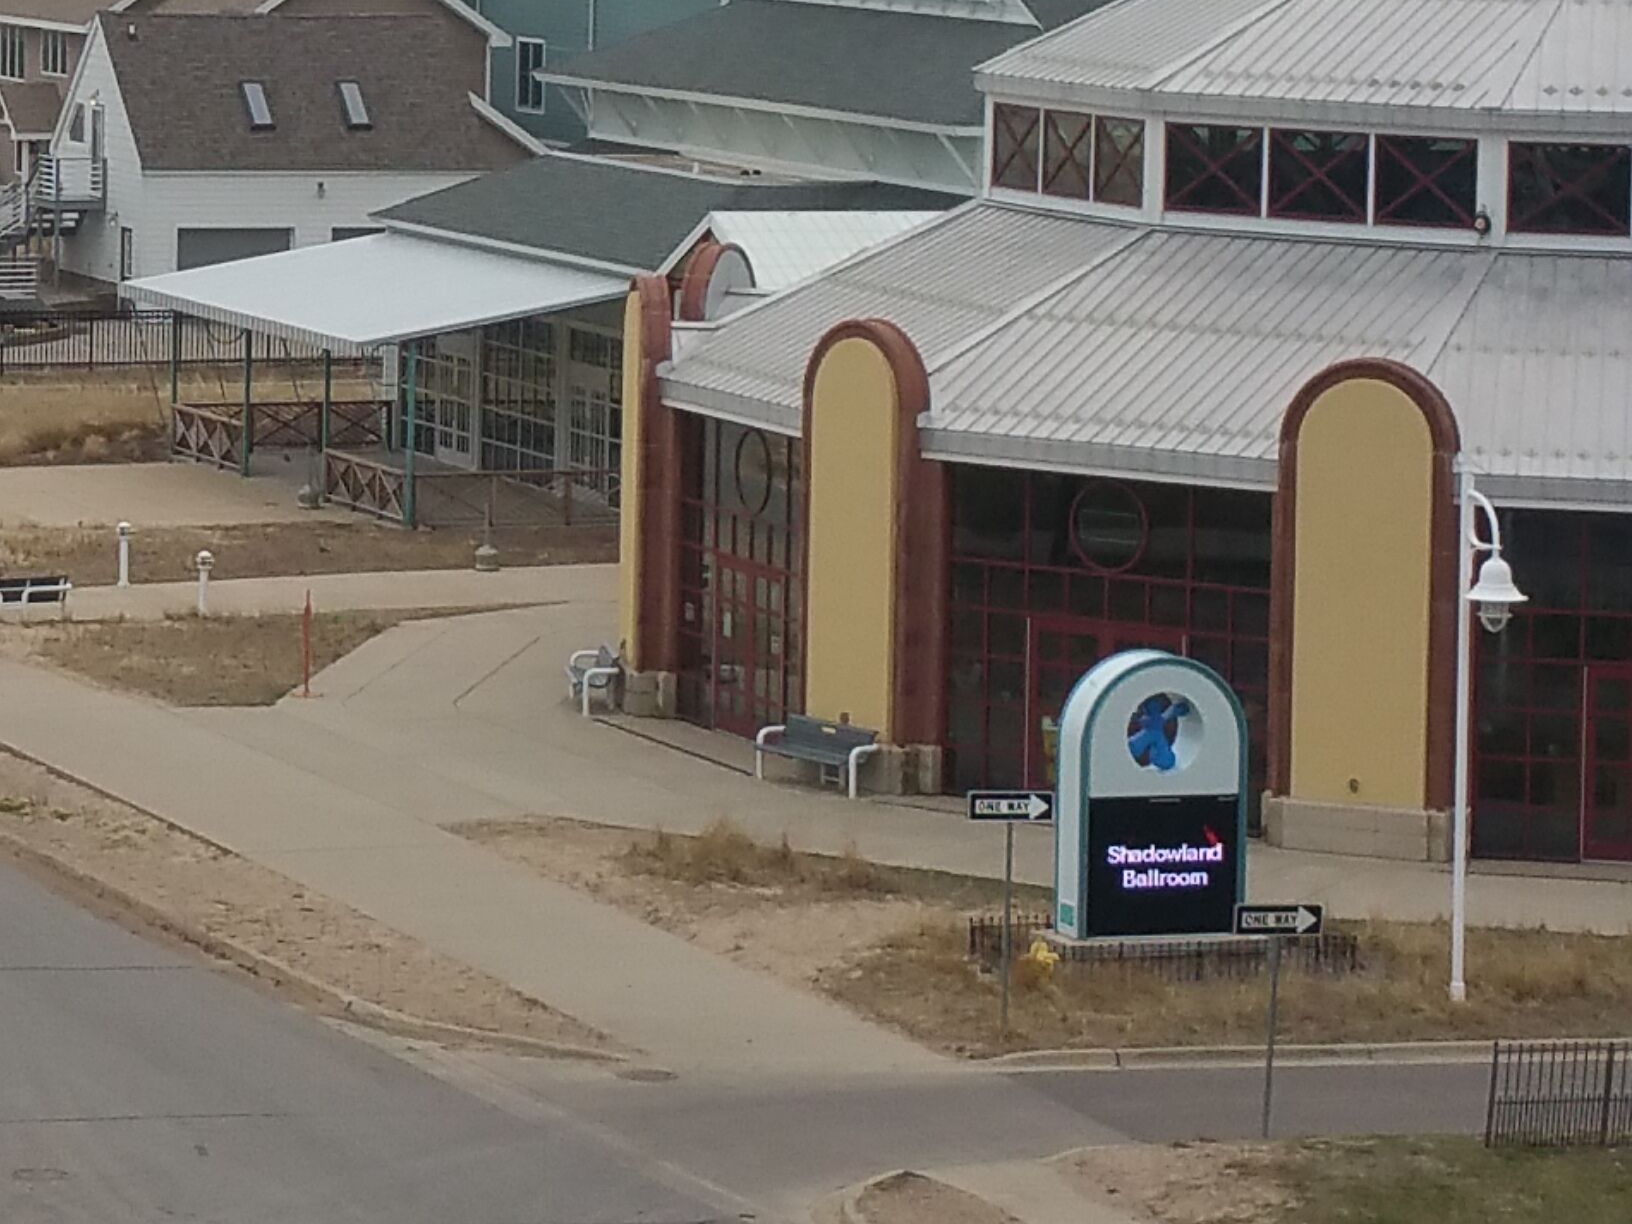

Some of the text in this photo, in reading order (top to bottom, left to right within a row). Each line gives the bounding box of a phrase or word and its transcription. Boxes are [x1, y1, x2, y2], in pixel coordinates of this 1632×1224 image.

[977, 800, 1029, 813] ONE WAY
[1107, 842, 1223, 864] Shadowland
[1122, 868, 1209, 888] Ballroom
[1245, 913, 1297, 927] ONE WAY
